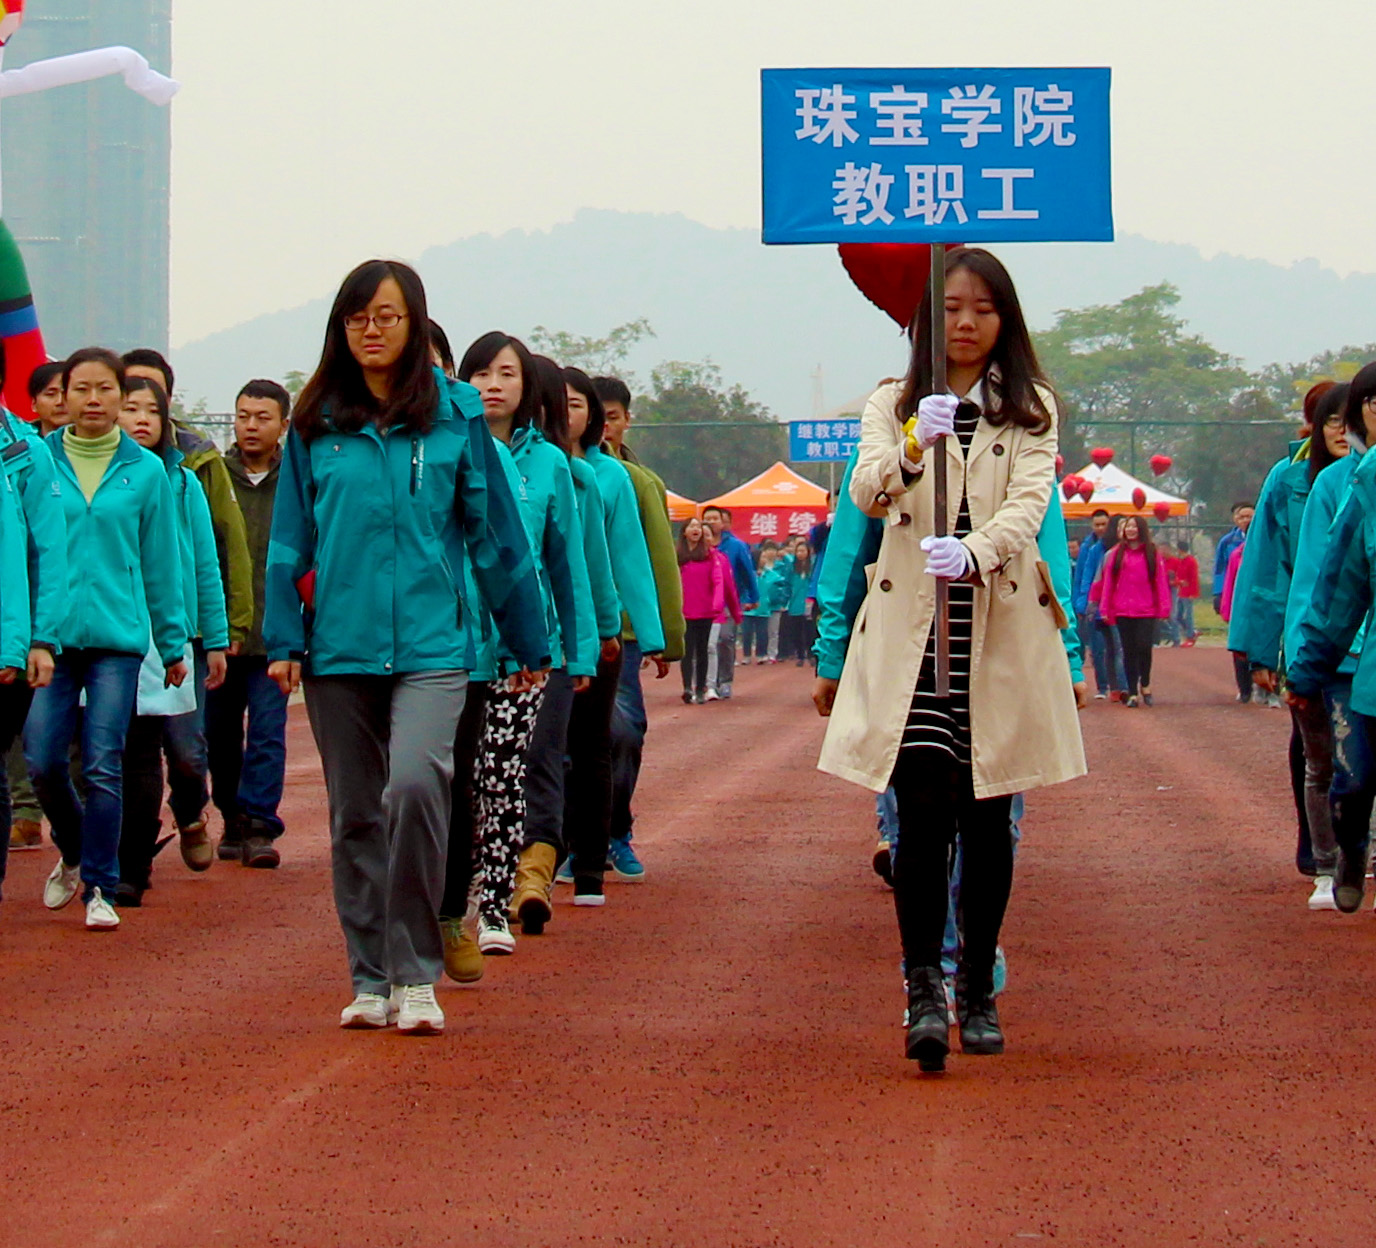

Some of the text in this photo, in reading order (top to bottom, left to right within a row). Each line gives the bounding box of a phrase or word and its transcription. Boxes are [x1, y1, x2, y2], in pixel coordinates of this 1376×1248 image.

[794, 83, 1077, 149] 珠宝学院
[831, 161, 1040, 226] 教职工
[806, 441, 856, 457] 教职工
[749, 511, 817, 537] 继续
